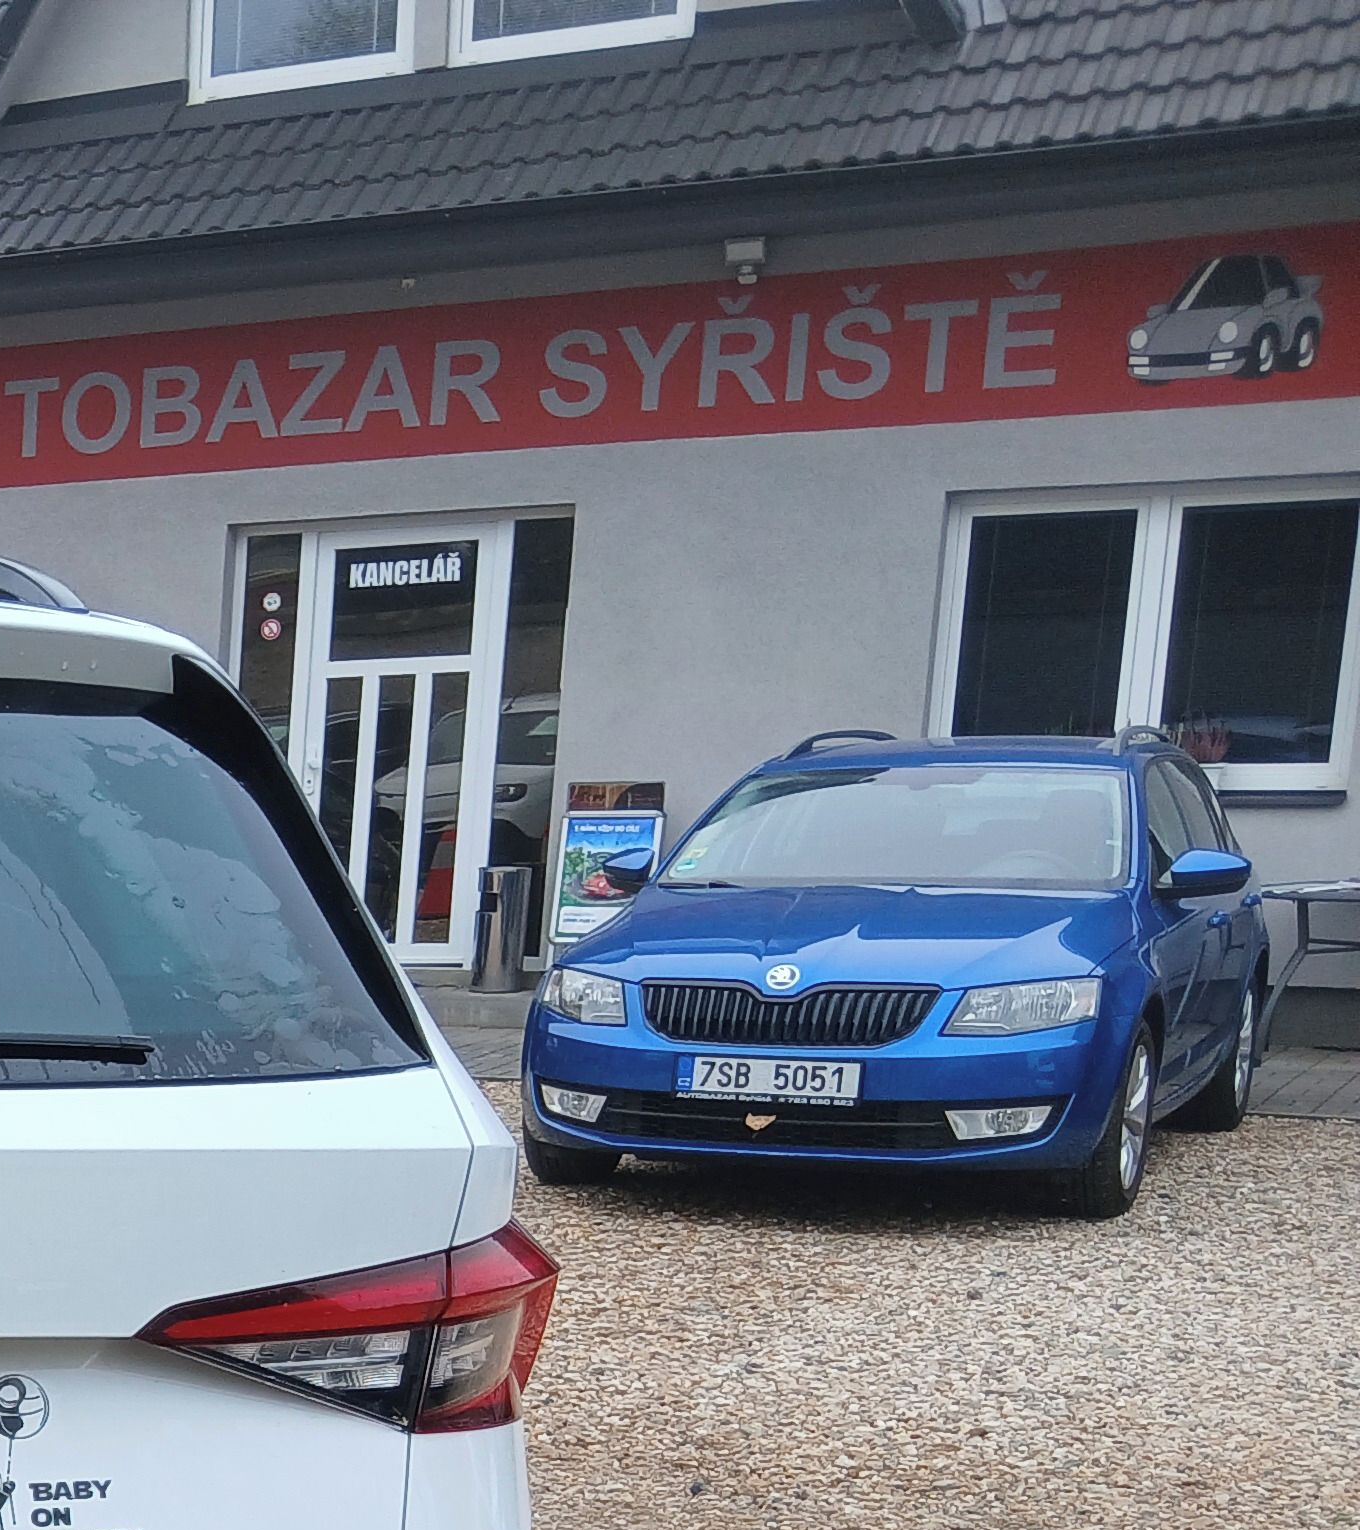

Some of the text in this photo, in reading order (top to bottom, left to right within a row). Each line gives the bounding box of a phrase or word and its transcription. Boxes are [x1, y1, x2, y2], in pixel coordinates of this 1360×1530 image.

[538, 271, 1062, 419] SYŘIŠTĚ
[349, 552, 461, 589] KANCELÁŘ
[699, 1060, 844, 1093] 7SB 5051
[676, 1091, 736, 1101] AUTOBAZAR
[29, 1479, 112, 1502] BABY
[31, 1507, 72, 1528] ON
